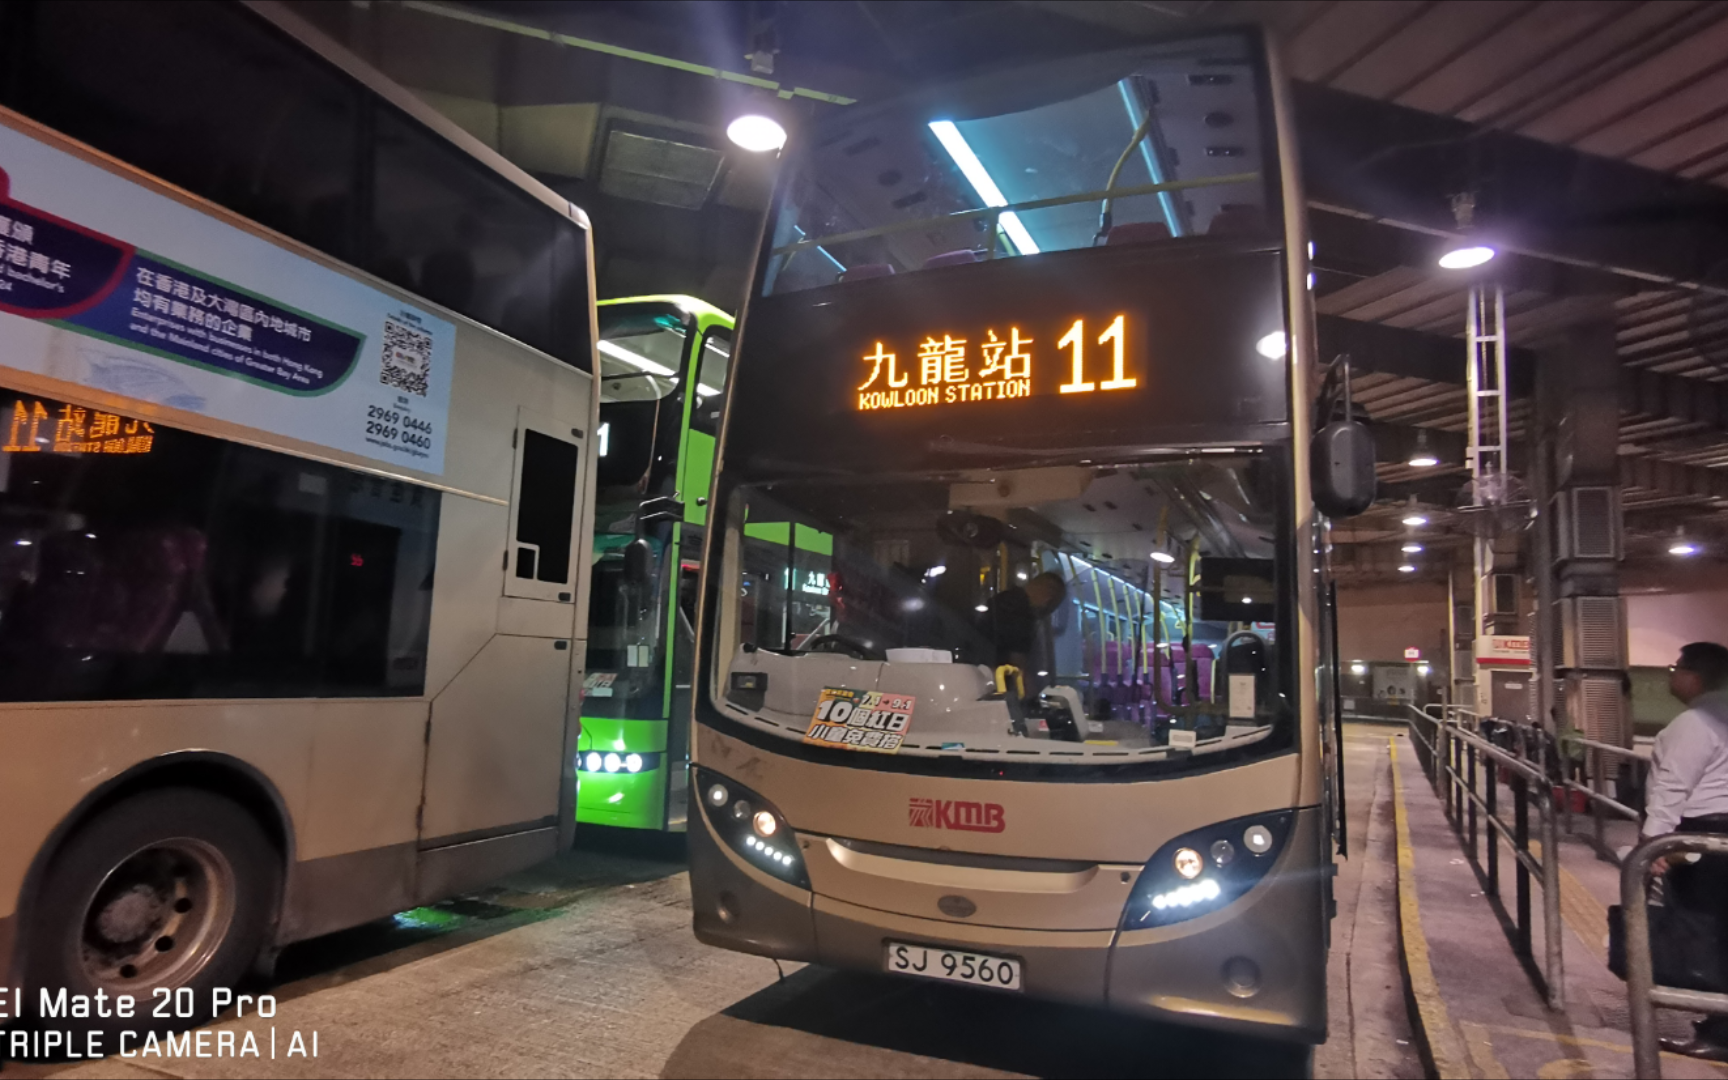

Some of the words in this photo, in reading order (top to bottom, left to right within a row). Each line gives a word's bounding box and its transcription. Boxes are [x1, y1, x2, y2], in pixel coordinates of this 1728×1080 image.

[130, 323, 149, 334] and
[150, 328, 167, 340] the
[245, 357, 275, 373] Greater
[276, 366, 292, 380] Bay
[292, 373, 311, 384] Area
[262, 350, 281, 362] both
[282, 357, 303, 372] Hong
[304, 364, 323, 379] Kong
[858, 327, 1033, 390] 九龍站
[1058, 314, 1137, 393] 11
[859, 387, 939, 411] KOWLOON
[944, 378, 1031, 403] STATION
[366, 420, 398, 440] 2969
[401, 430, 431, 450] 0460
[367, 404, 400, 425] 2969
[402, 415, 432, 435] 0446
[935, 799, 1006, 834] KMB
[895, 946, 928, 972] SJ
[940, 953, 1014, 985] 9560
